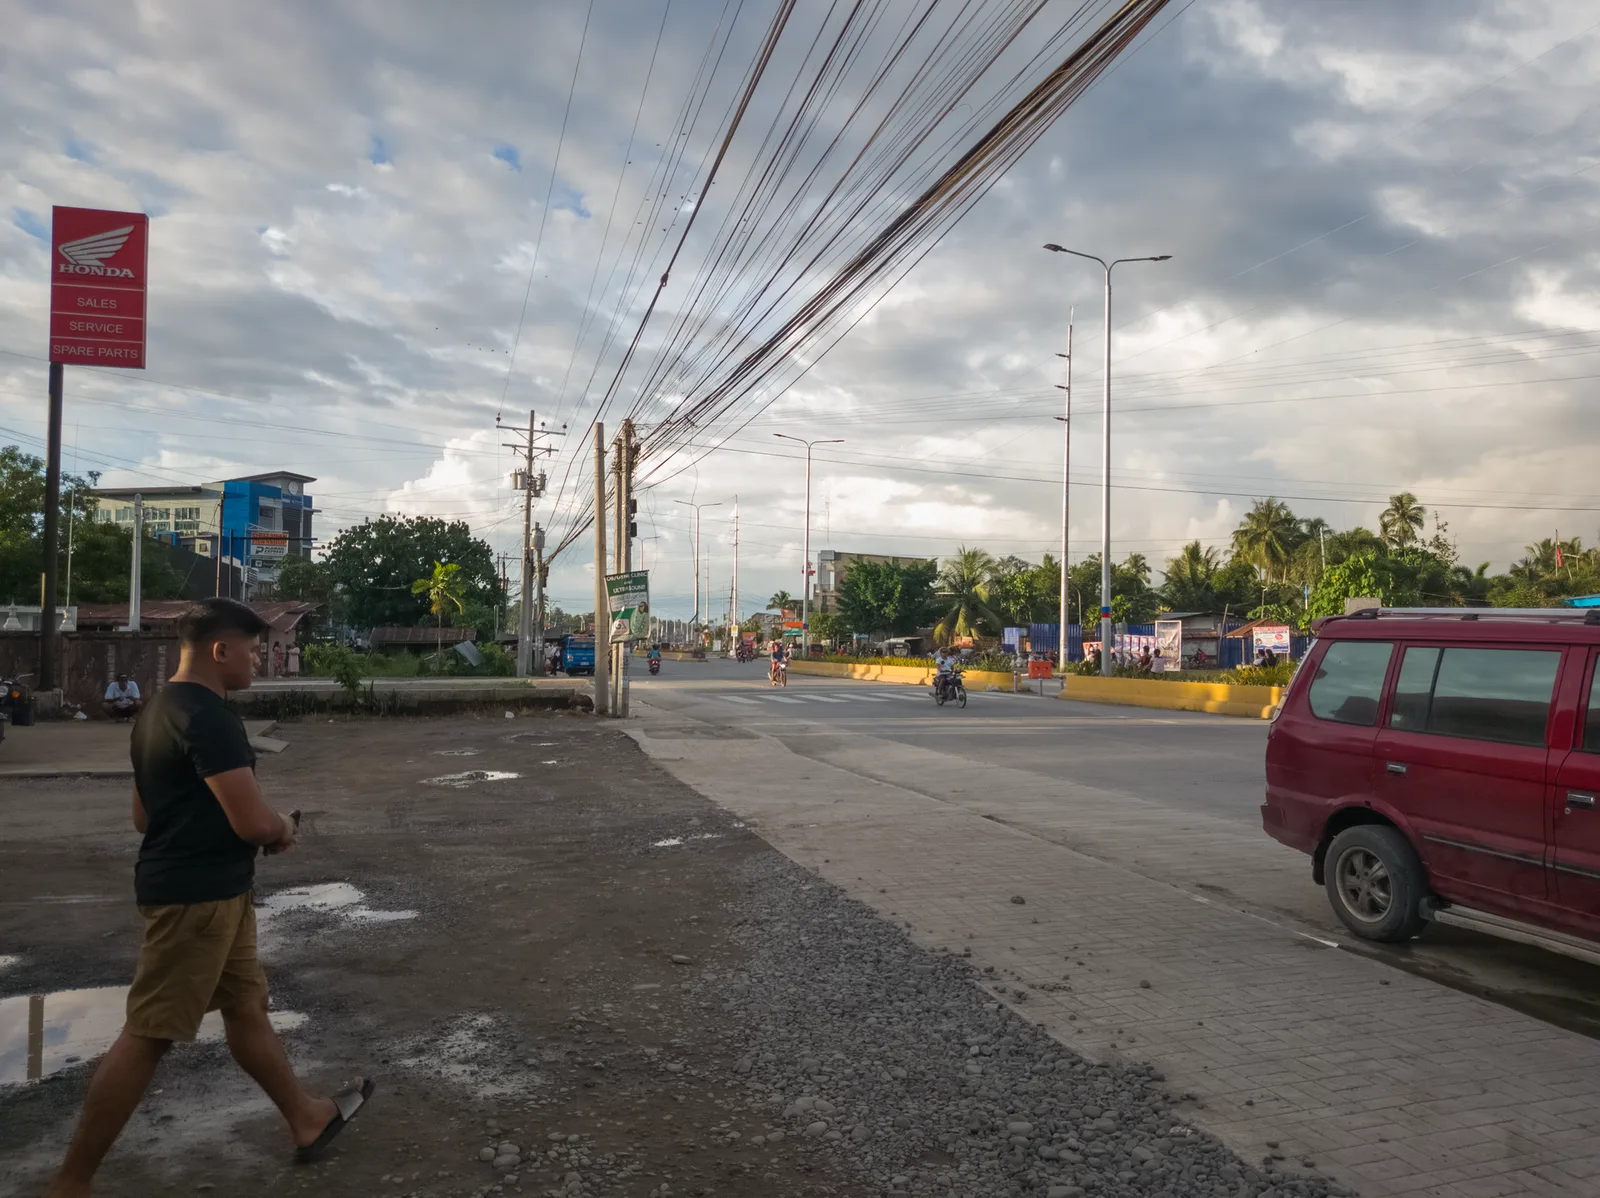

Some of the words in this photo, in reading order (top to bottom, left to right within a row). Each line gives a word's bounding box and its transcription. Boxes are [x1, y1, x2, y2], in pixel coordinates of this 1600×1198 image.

[58, 263, 135, 278] HONDA
[76, 297, 117, 309] SALES
[69, 321, 123, 334] SERVICE
[52, 344, 95, 357] SPARE
[98, 347, 138, 359] PARTS
[612, 585, 646, 594] ULTRASOUND
